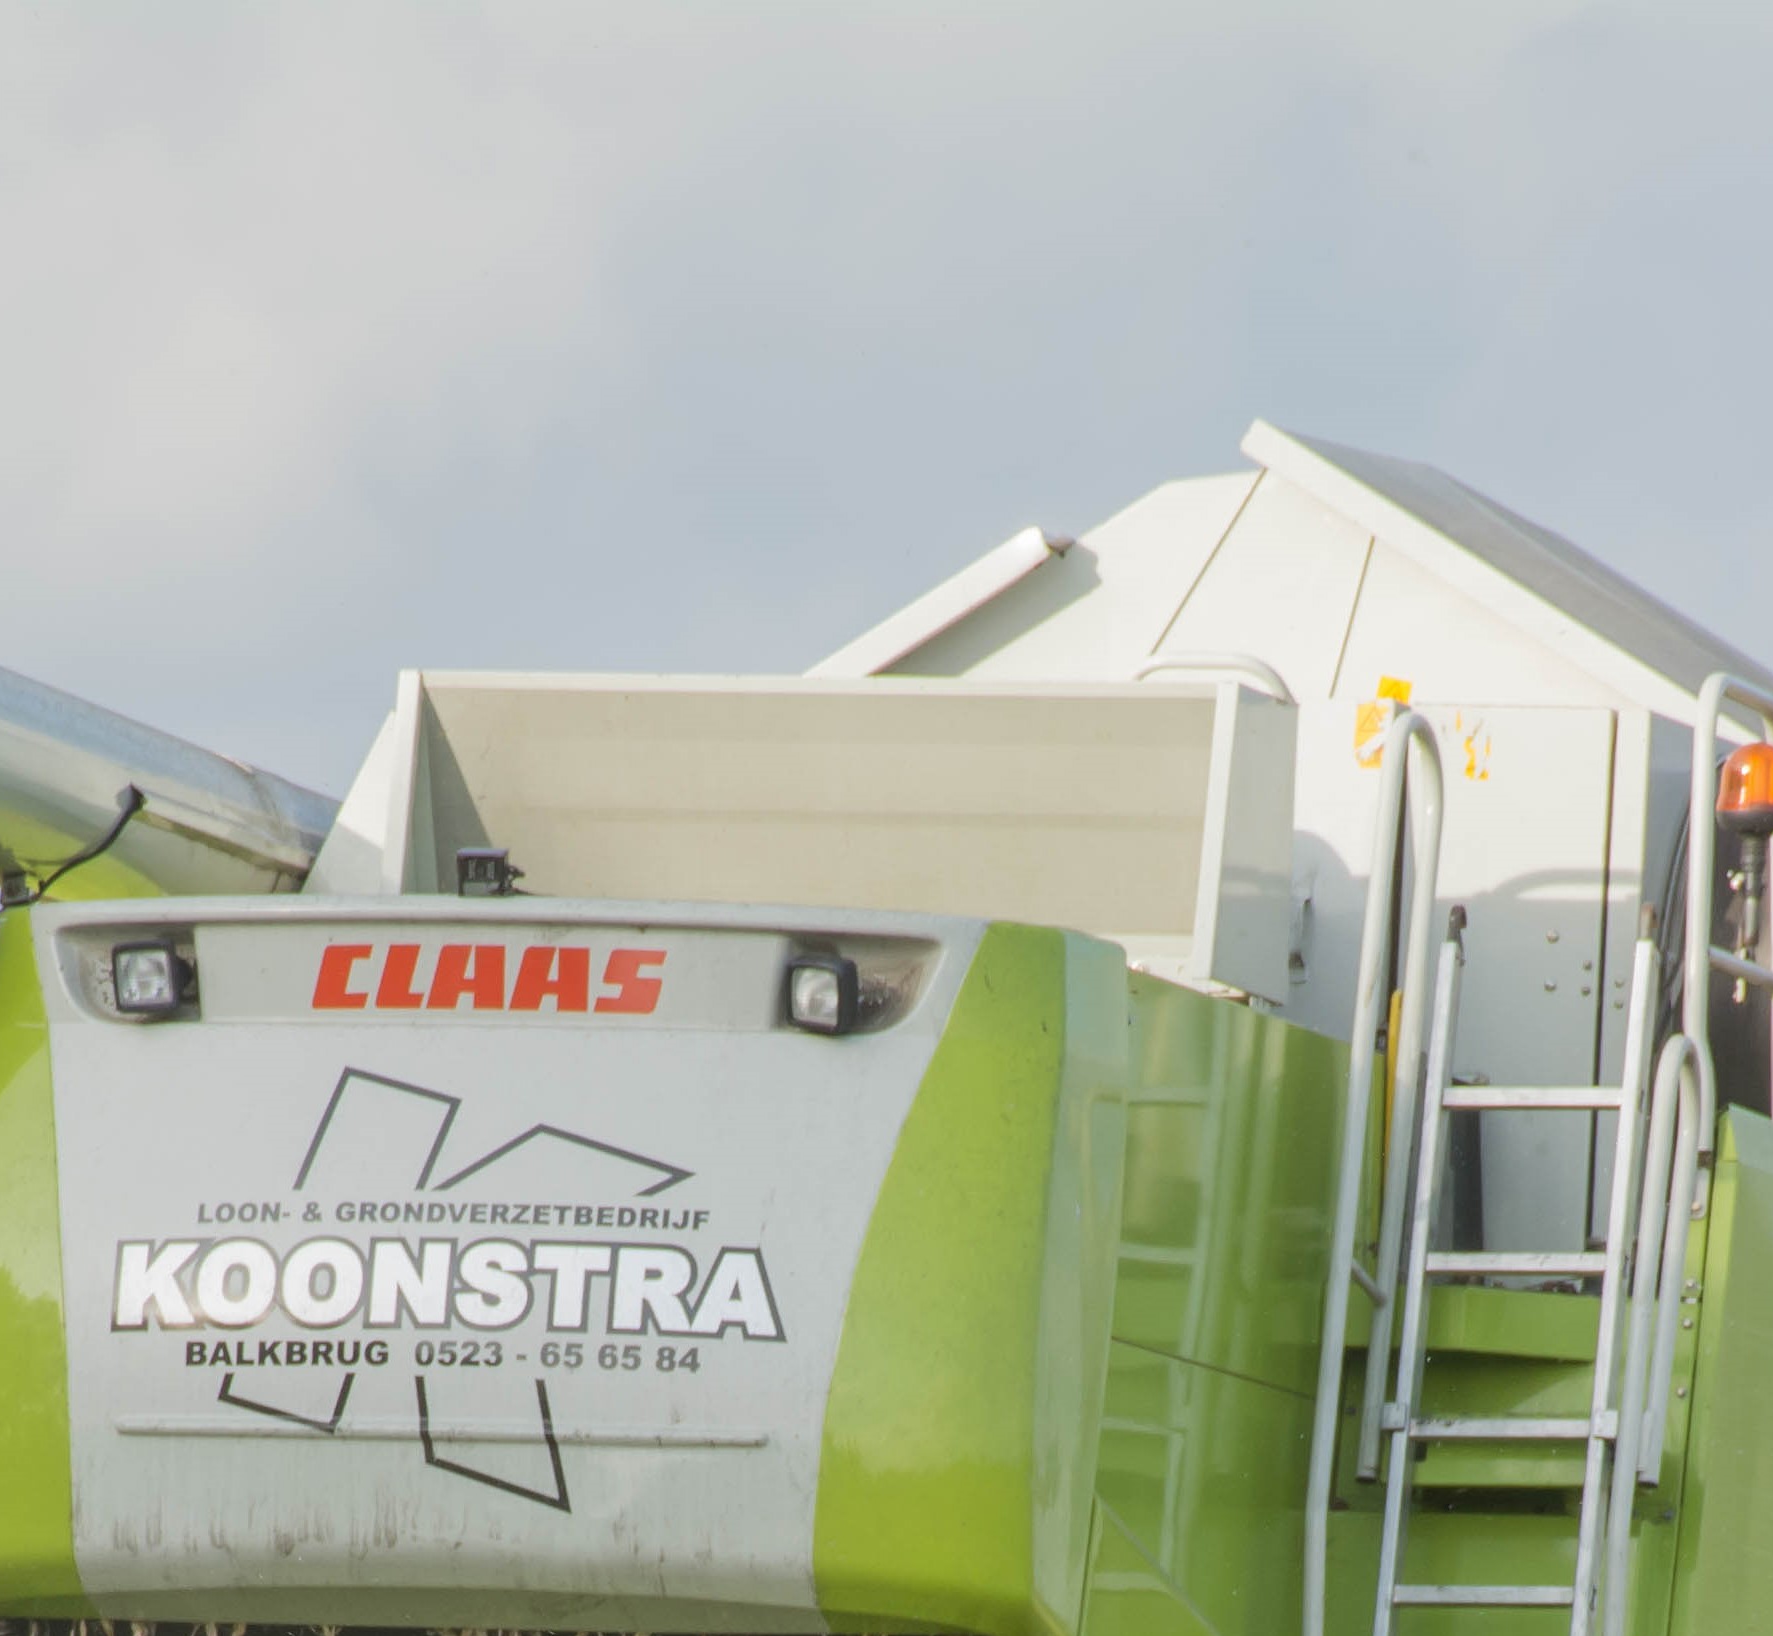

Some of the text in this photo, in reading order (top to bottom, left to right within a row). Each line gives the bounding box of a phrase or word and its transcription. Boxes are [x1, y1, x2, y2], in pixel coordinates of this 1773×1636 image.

[312, 943, 668, 1014] CLAAS
[197, 1201, 711, 1231] LOON- & GRONDVERZETBEDRIJF
[111, 1235, 787, 1343] KOONSTRA
[185, 1340, 389, 1367] BALKBRUG
[414, 1340, 503, 1367] 0523
[539, 1342, 584, 1369] 65
[597, 1344, 642, 1371] 65
[654, 1346, 701, 1373] 84
